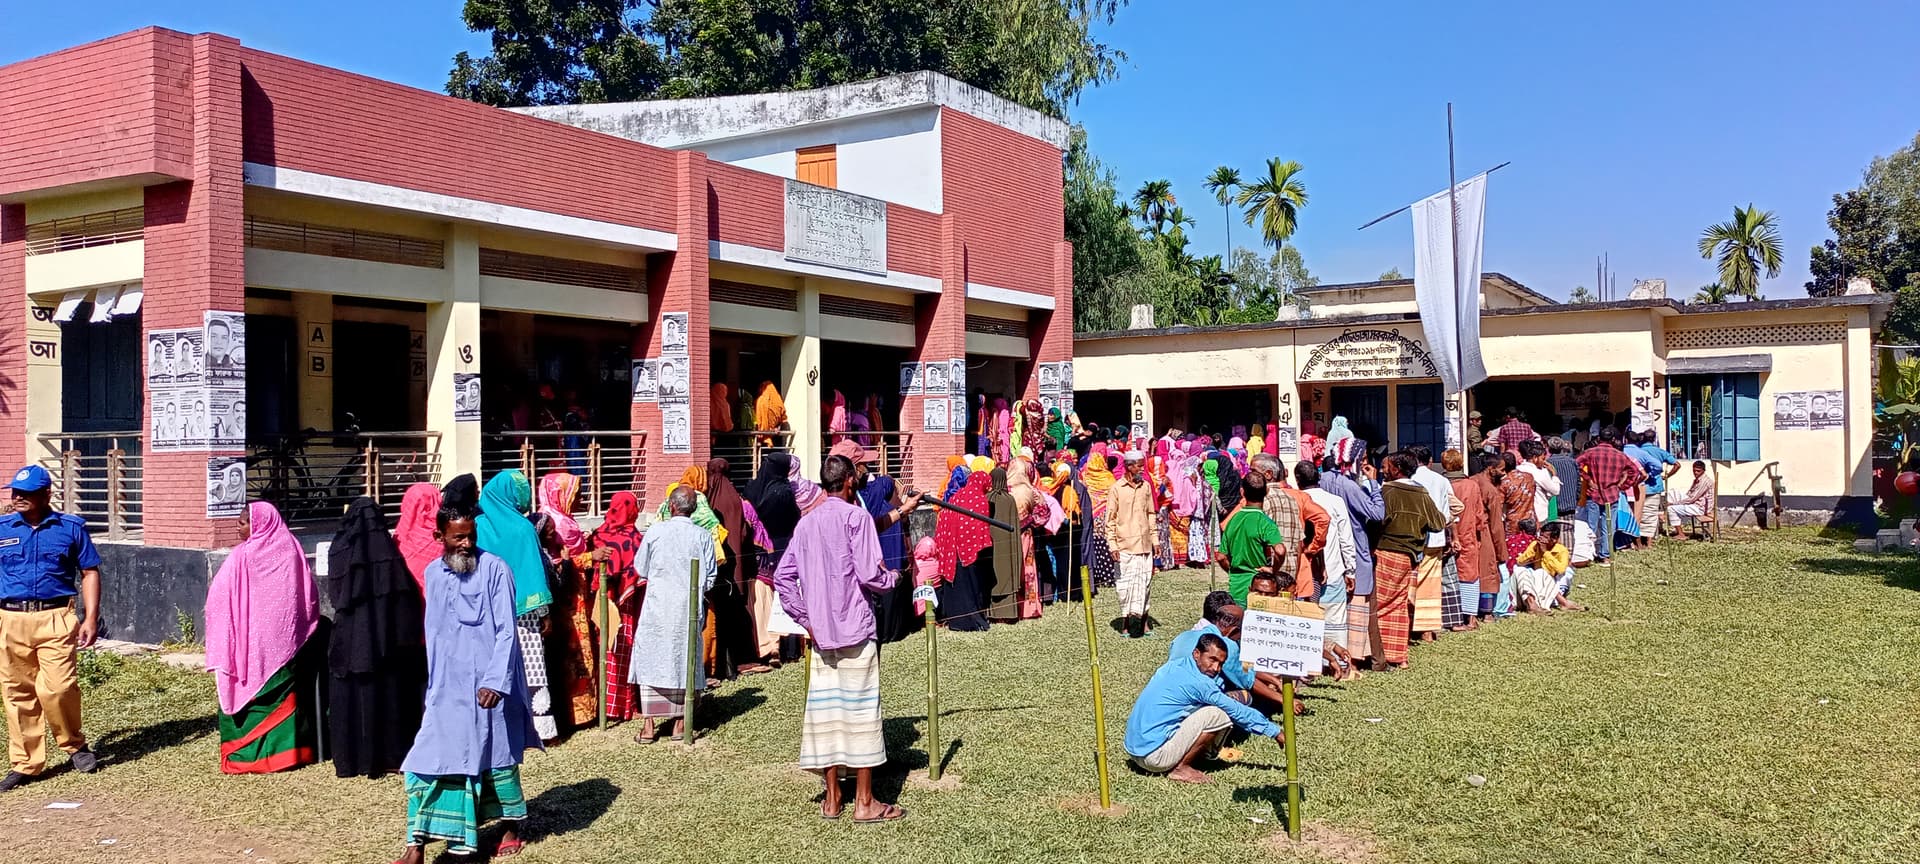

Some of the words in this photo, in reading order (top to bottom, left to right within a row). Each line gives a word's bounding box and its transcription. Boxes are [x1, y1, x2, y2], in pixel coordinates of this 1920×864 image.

[31, 306, 55, 323] অ
[311, 327, 325, 342] A
[30, 341, 57, 359] আ
[458, 344, 473, 364] ও
[312, 356, 325, 372] B
[1631, 377, 1651, 391] ক
[1133, 394, 1143, 406] A
[1279, 392, 1290, 406] এ
[1634, 395, 1651, 411] খ
[1134, 409, 1144, 420] B
[1256, 614, 1272, 623] রুম
[1274, 617, 1288, 627] নং
[1298, 621, 1312, 629] ০১
[1256, 656, 1304, 672] প্রবেশ
